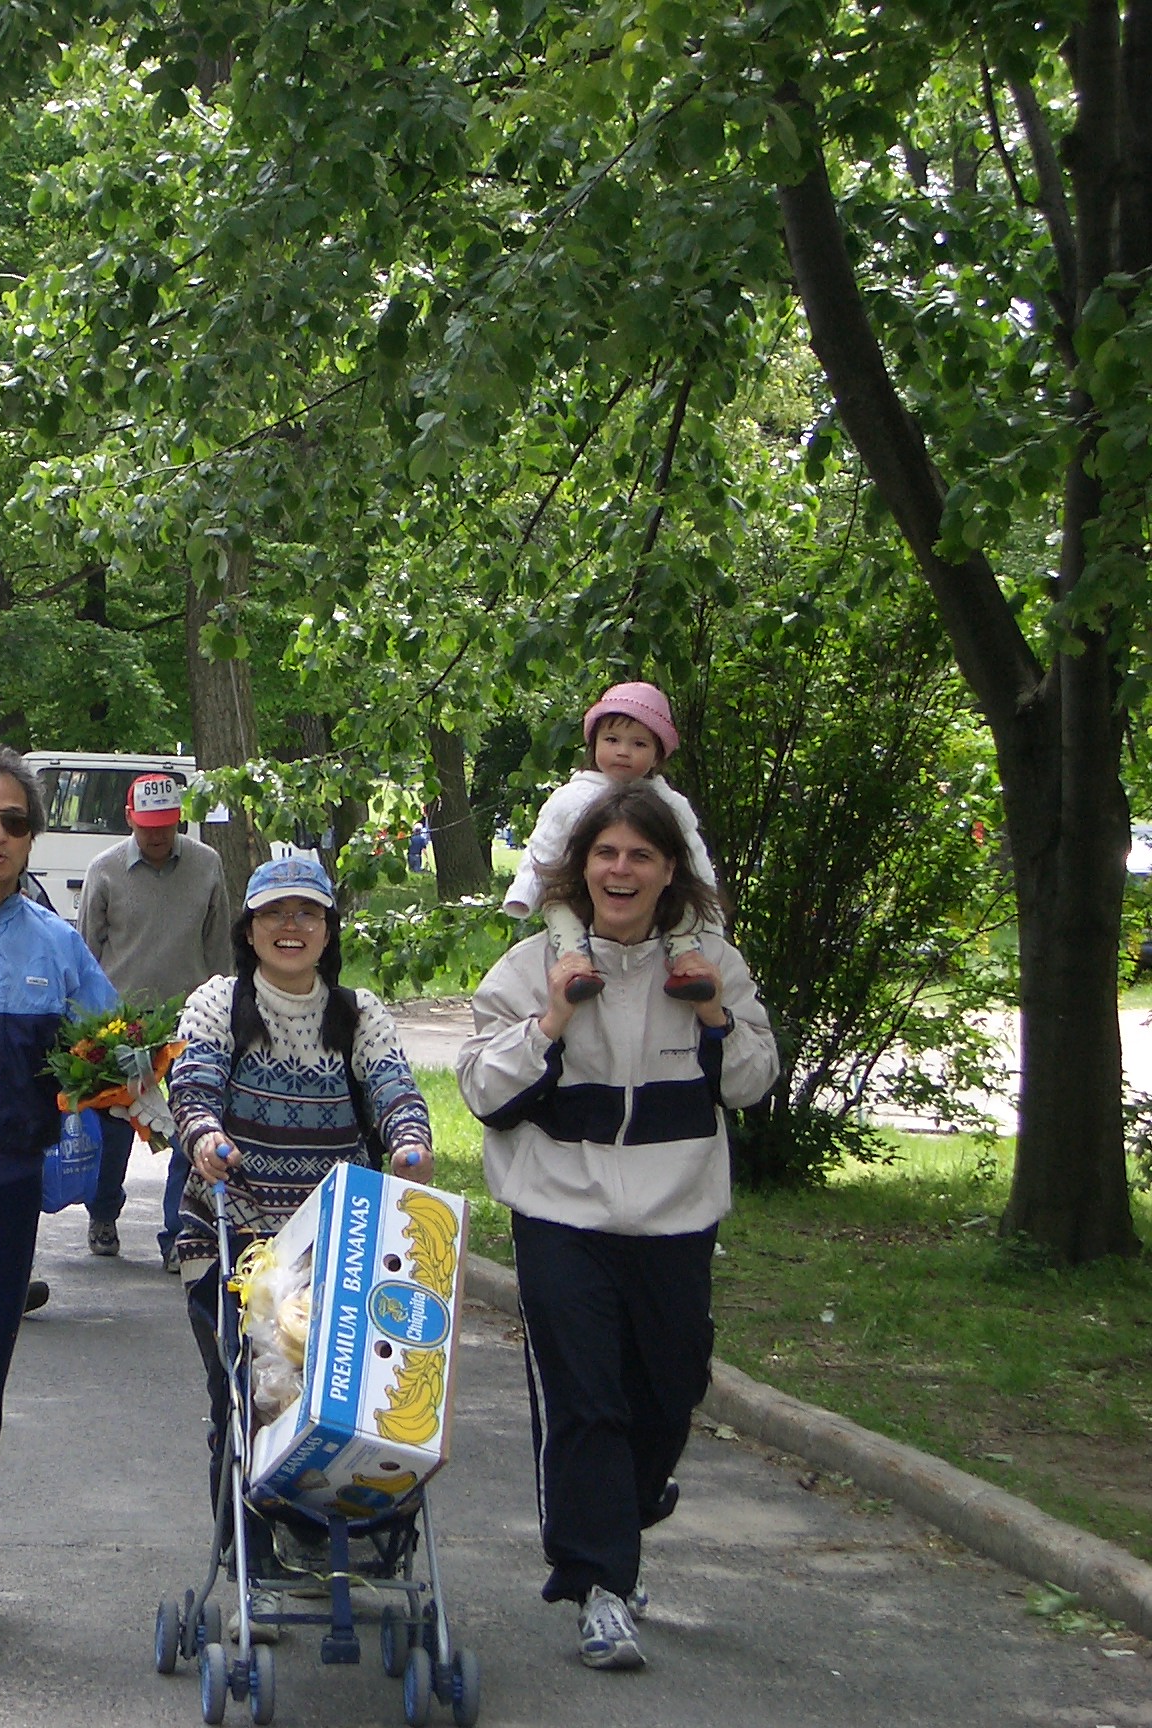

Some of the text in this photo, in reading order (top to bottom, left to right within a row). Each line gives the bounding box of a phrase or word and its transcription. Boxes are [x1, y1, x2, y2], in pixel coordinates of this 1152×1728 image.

[144, 780, 172, 795] 6916
[330, 1196, 370, 1402] PREMIUM BANANAS
[406, 1291, 426, 1342] Chiquita
[282, 1437, 323, 1474] BANANAS
